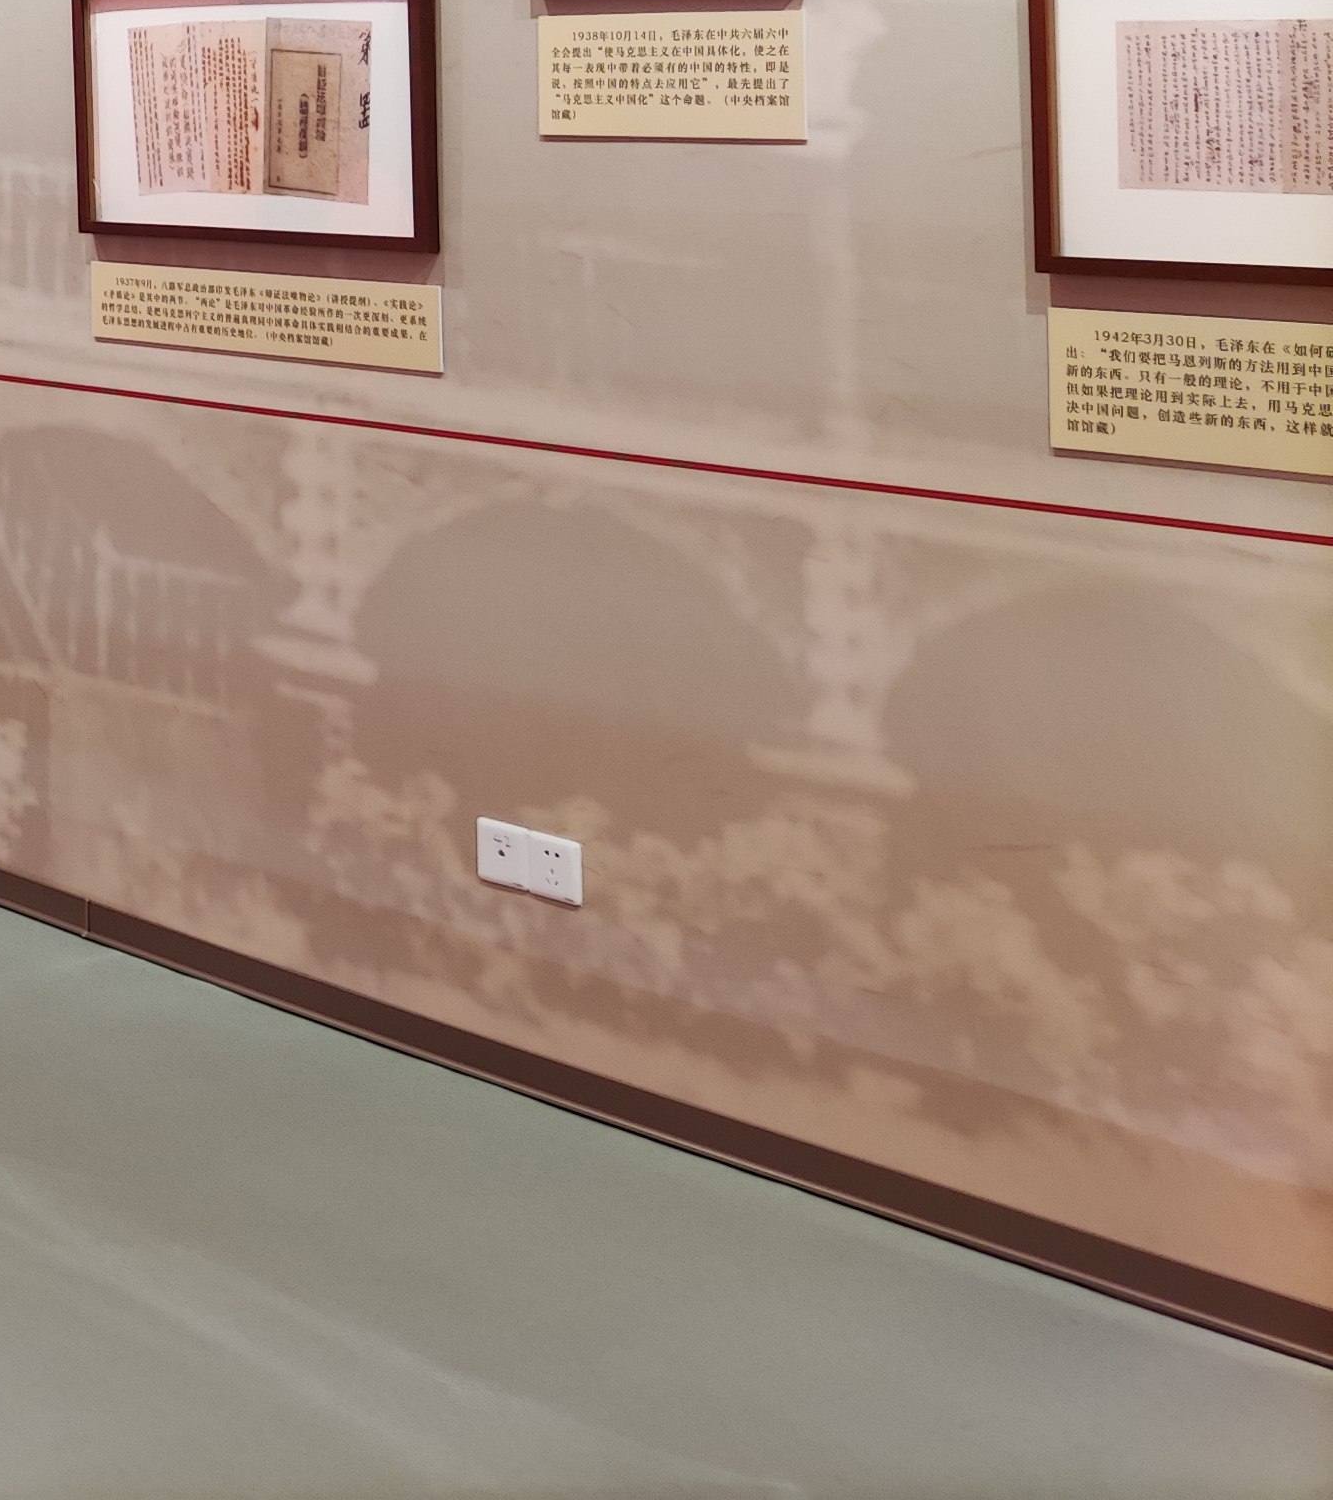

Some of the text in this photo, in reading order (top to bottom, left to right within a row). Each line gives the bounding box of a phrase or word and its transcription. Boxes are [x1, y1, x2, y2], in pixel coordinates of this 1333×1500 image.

[572, 27, 789, 42] 1938年10月14日，毛泽东在中共六届六中
